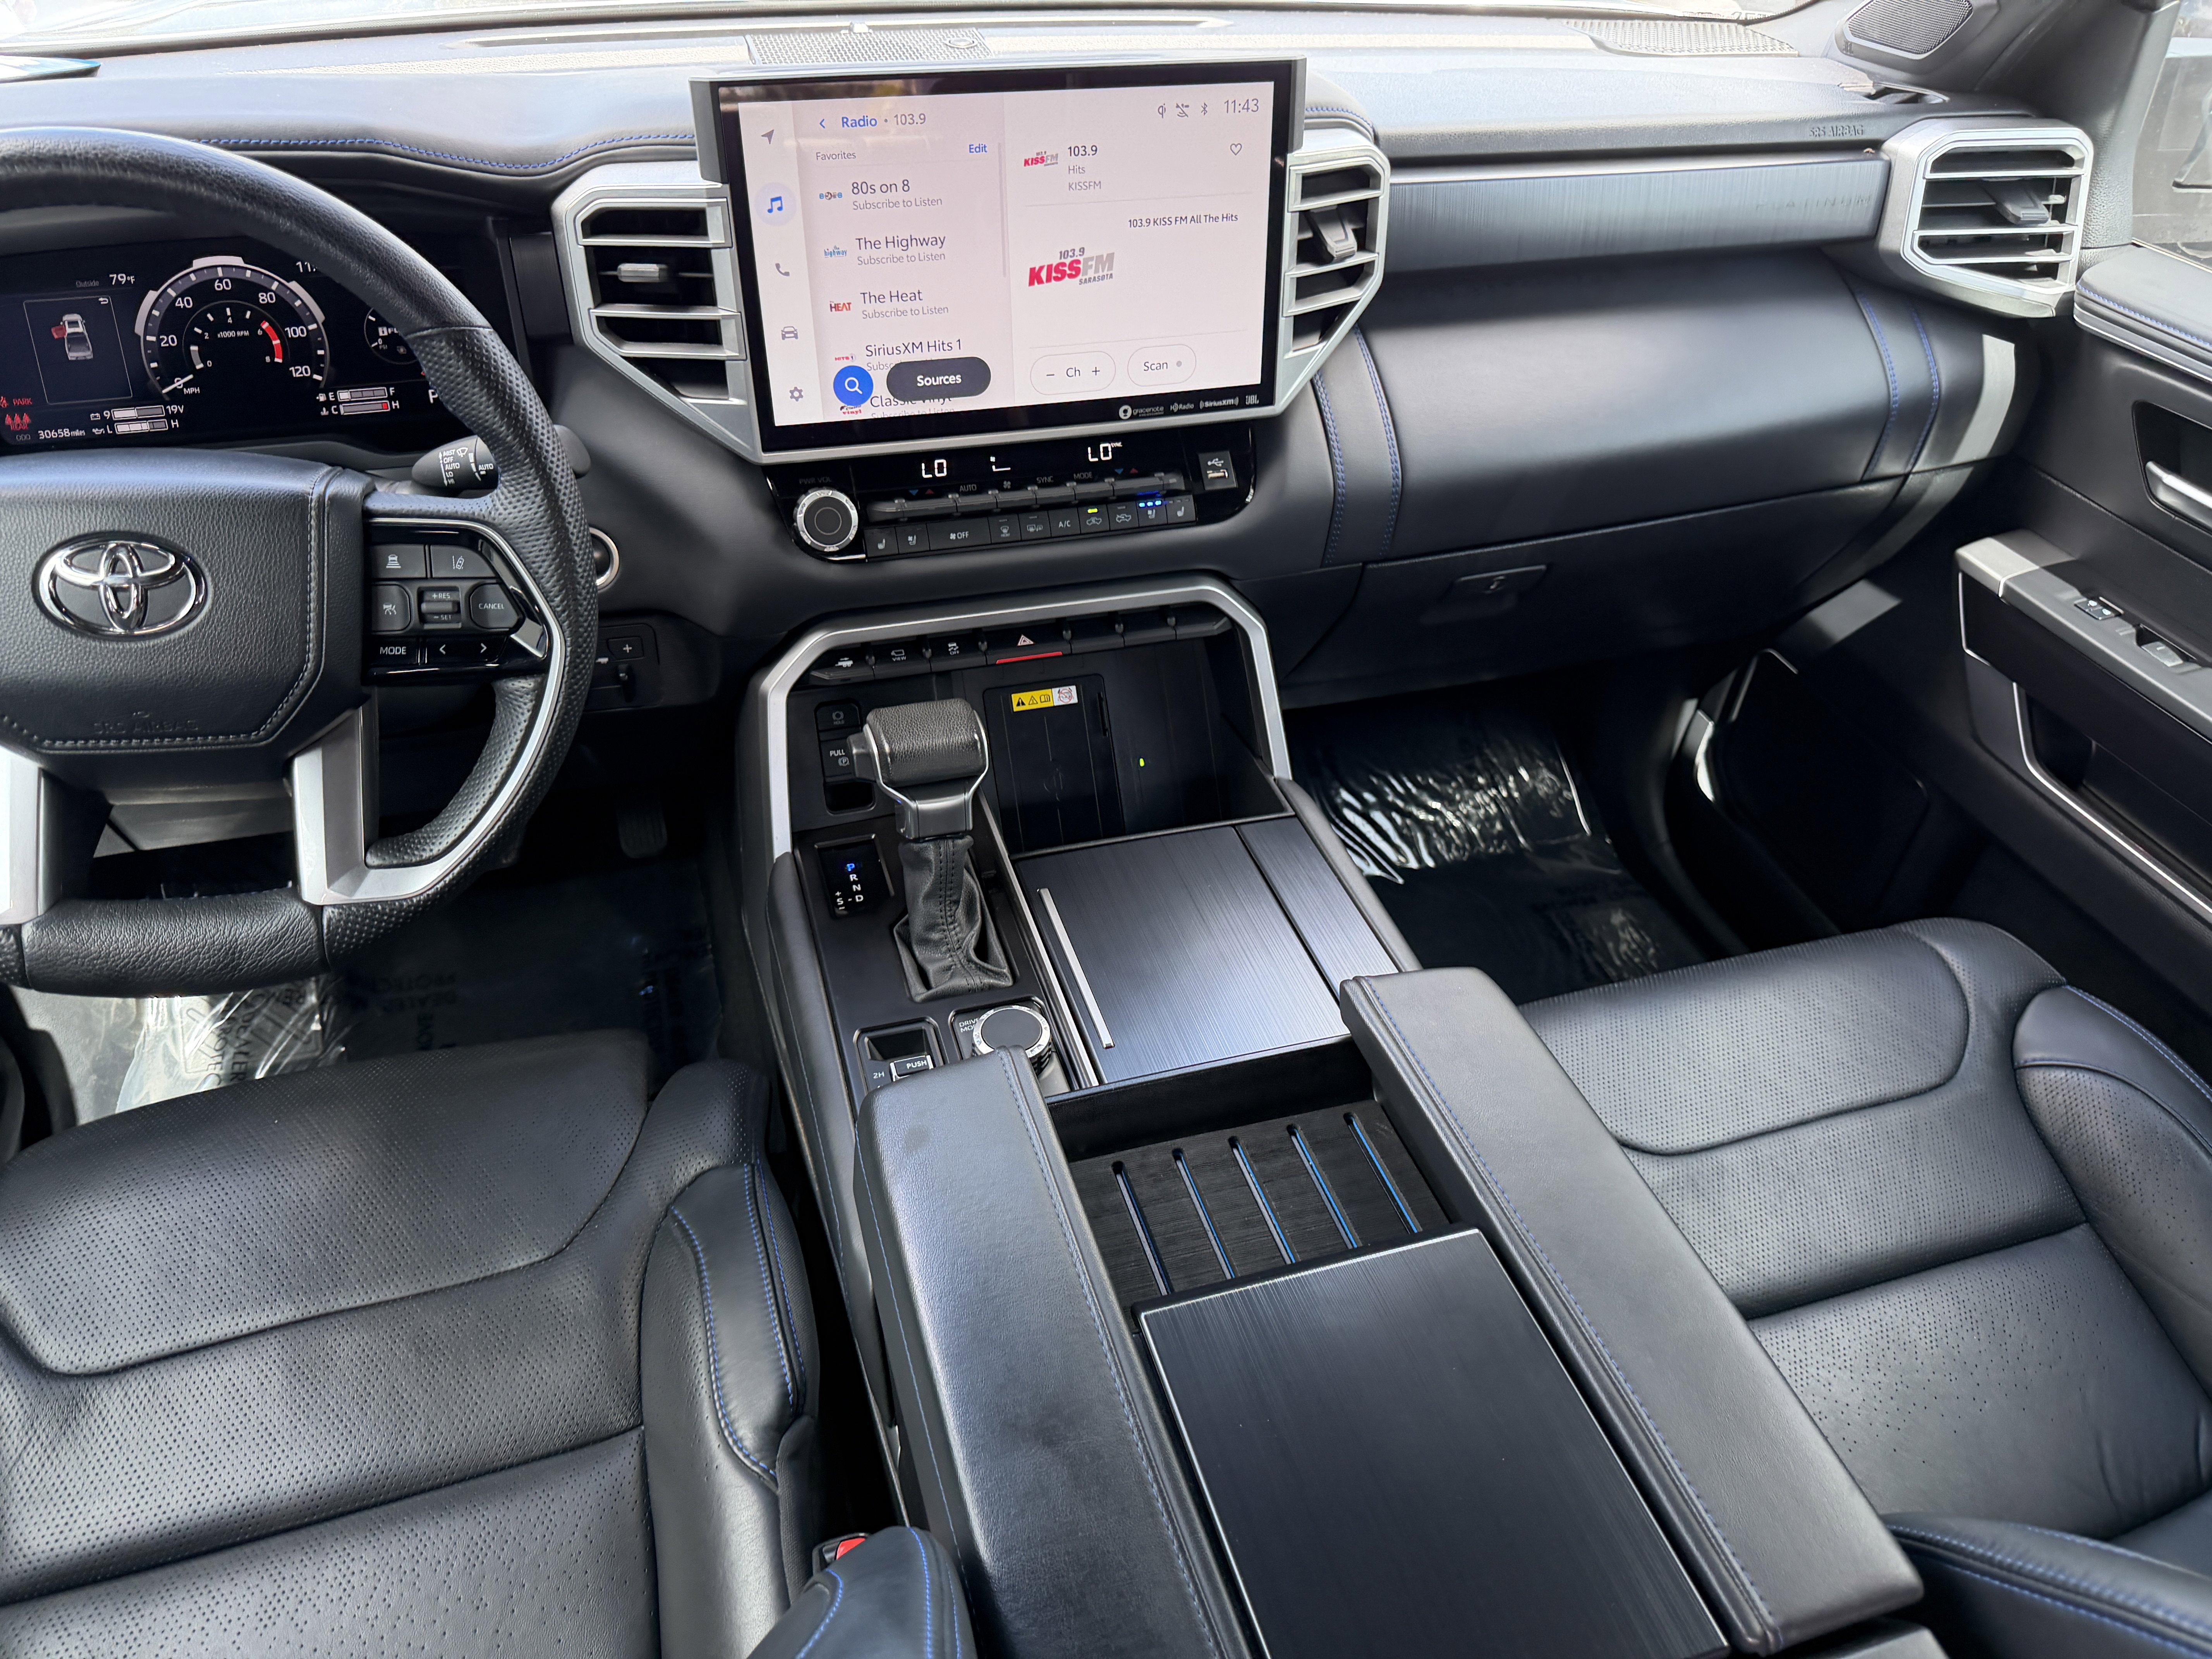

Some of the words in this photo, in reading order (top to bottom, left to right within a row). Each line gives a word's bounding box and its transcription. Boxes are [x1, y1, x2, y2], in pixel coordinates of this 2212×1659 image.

[1224, 98, 1259, 113] 11:43
[841, 115, 878, 128] Radio
[894, 113, 926, 126] 103.9
[1809, 127, 1826, 137] SRS
[1828, 125, 1864, 137] AIRBAG
[969, 144, 987, 153] Edit
[1068, 145, 1097, 156] 103.9
[816, 151, 856, 160] Favorites
[1068, 165, 1085, 174] Hits
[852, 182, 876, 195] 80s
[880, 183, 898, 193] on
[902, 179, 910, 192] 8
[1068, 180, 1101, 191] KISSFM
[852, 199, 900, 210] Subscribe
[903, 199, 912, 208] to
[915, 197, 943, 207] Listen
[1128, 218, 1151, 228] 103.9
[1152, 216, 1173, 227] KISS
[1175, 216, 1188, 225] FM
[1189, 215, 1201, 224] All
[1203, 214, 1219, 223] The
[1221, 213, 1238, 222] Hits
[855, 237, 881, 250] The
[885, 235, 946, 251] Highway
[824, 248, 847, 258] highway
[857, 254, 904, 265] Subscribe
[906, 254, 916, 263] to
[918, 252, 945, 262] Listen
[1058, 247, 1085, 260] 103.9
[1028, 252, 1115, 287] KISSFM
[215, 279, 232, 290] 60
[1079, 273, 1113, 285] SARASOTA
[175, 297, 193, 308] 40
[259, 292, 276, 304] 80
[860, 291, 886, 304] The
[890, 290, 923, 302] Heat
[830, 302, 852, 312] HEAT
[862, 308, 908, 319] Subscribe
[922, 306, 949, 316] Listen
[285, 326, 307, 338] 100
[160, 335, 177, 347] 20
[866, 342, 923, 357] SiriusXM
[927, 340, 953, 353] Hits
[956, 338, 962, 350] 1
[1143, 361, 1168, 371] Scan
[289, 366, 311, 378] 120
[1066, 368, 1080, 378] Ch
[917, 374, 962, 386] Sources
[184, 387, 200, 395] MPH
[329, 392, 335, 401] E
[13, 398, 32, 406] PARK
[428, 390, 438, 404] P
[1245, 395, 1259, 405] JBL
[166, 405, 184, 414] 19V
[331, 406, 338, 414] C
[392, 400, 399, 409] H
[103, 411, 110, 420] 9
[107, 425, 112, 434] L
[171, 420, 179, 428] H
[960, 484, 977, 492] AUTO
[380, 646, 407, 655] MODE
[847, 863, 855, 871] P
[906, 1060, 927, 1069] PUSH
